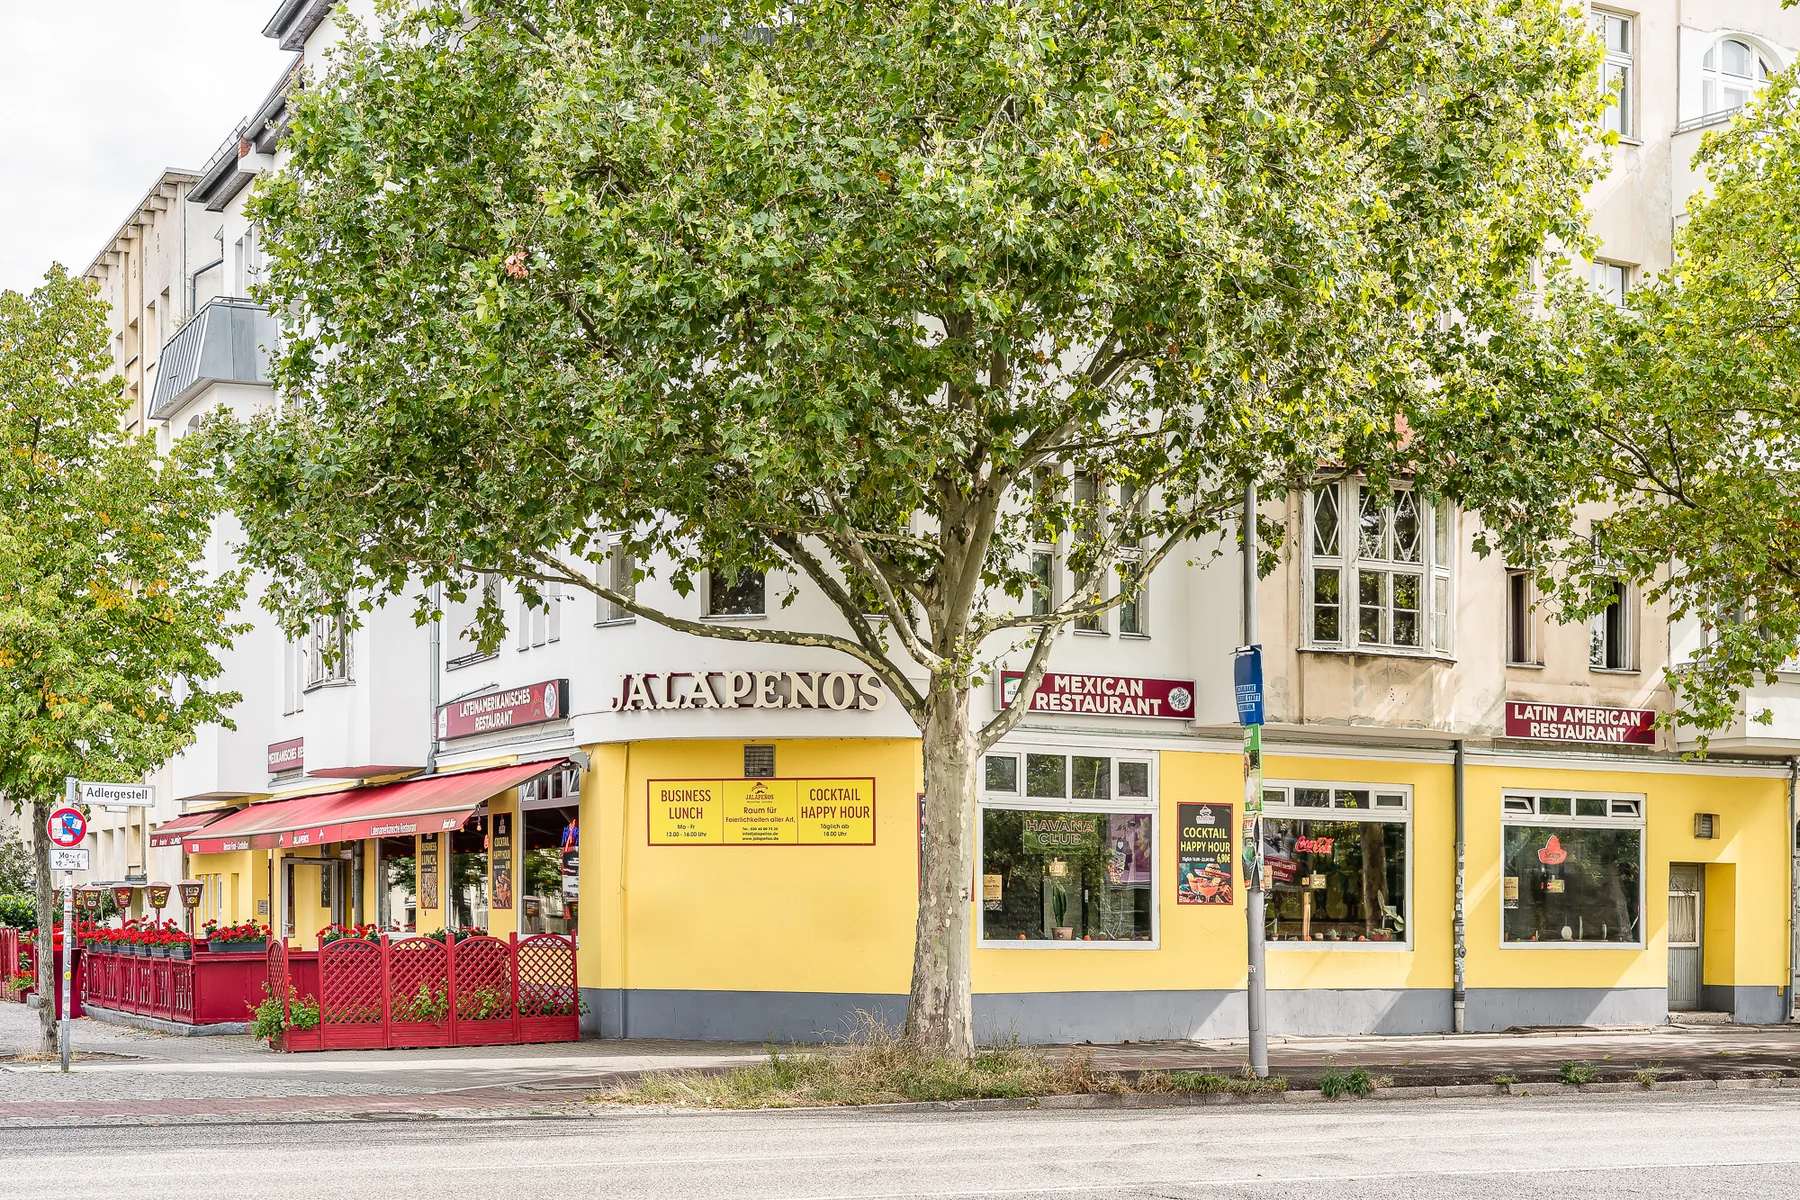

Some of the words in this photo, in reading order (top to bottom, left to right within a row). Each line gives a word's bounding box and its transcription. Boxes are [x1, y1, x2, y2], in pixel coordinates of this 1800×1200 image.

[1054, 675, 1143, 696] MEXICAN
[460, 688, 530, 718] LATEINAMERIKANISCHES
[1036, 693, 1162, 715] RESTAURANT
[475, 710, 513, 731] RESTAURANT
[1514, 704, 1557, 722] LATIN
[1563, 708, 1640, 726] AMERICAN
[1530, 722, 1626, 742] RESTAURANT
[86, 787, 148, 800] Adlergestell
[661, 790, 711, 802] BUSINESS
[810, 788, 861, 801] COCKTAIL
[669, 807, 703, 819] LUNCH
[801, 806, 836, 818] HAPPY
[840, 806, 870, 818] HOUR
[1025, 820, 1095, 832] HAVANA
[1183, 827, 1227, 838] COCKTAIL
[494, 837, 510, 846] COCKTAIL
[1038, 833, 1082, 845] CLUB
[422, 842, 437, 851] BUSINESS
[1181, 841, 1207, 852] HAPPY
[1208, 842, 1230, 852] HOUR
[422, 855, 437, 865] LUNCH
